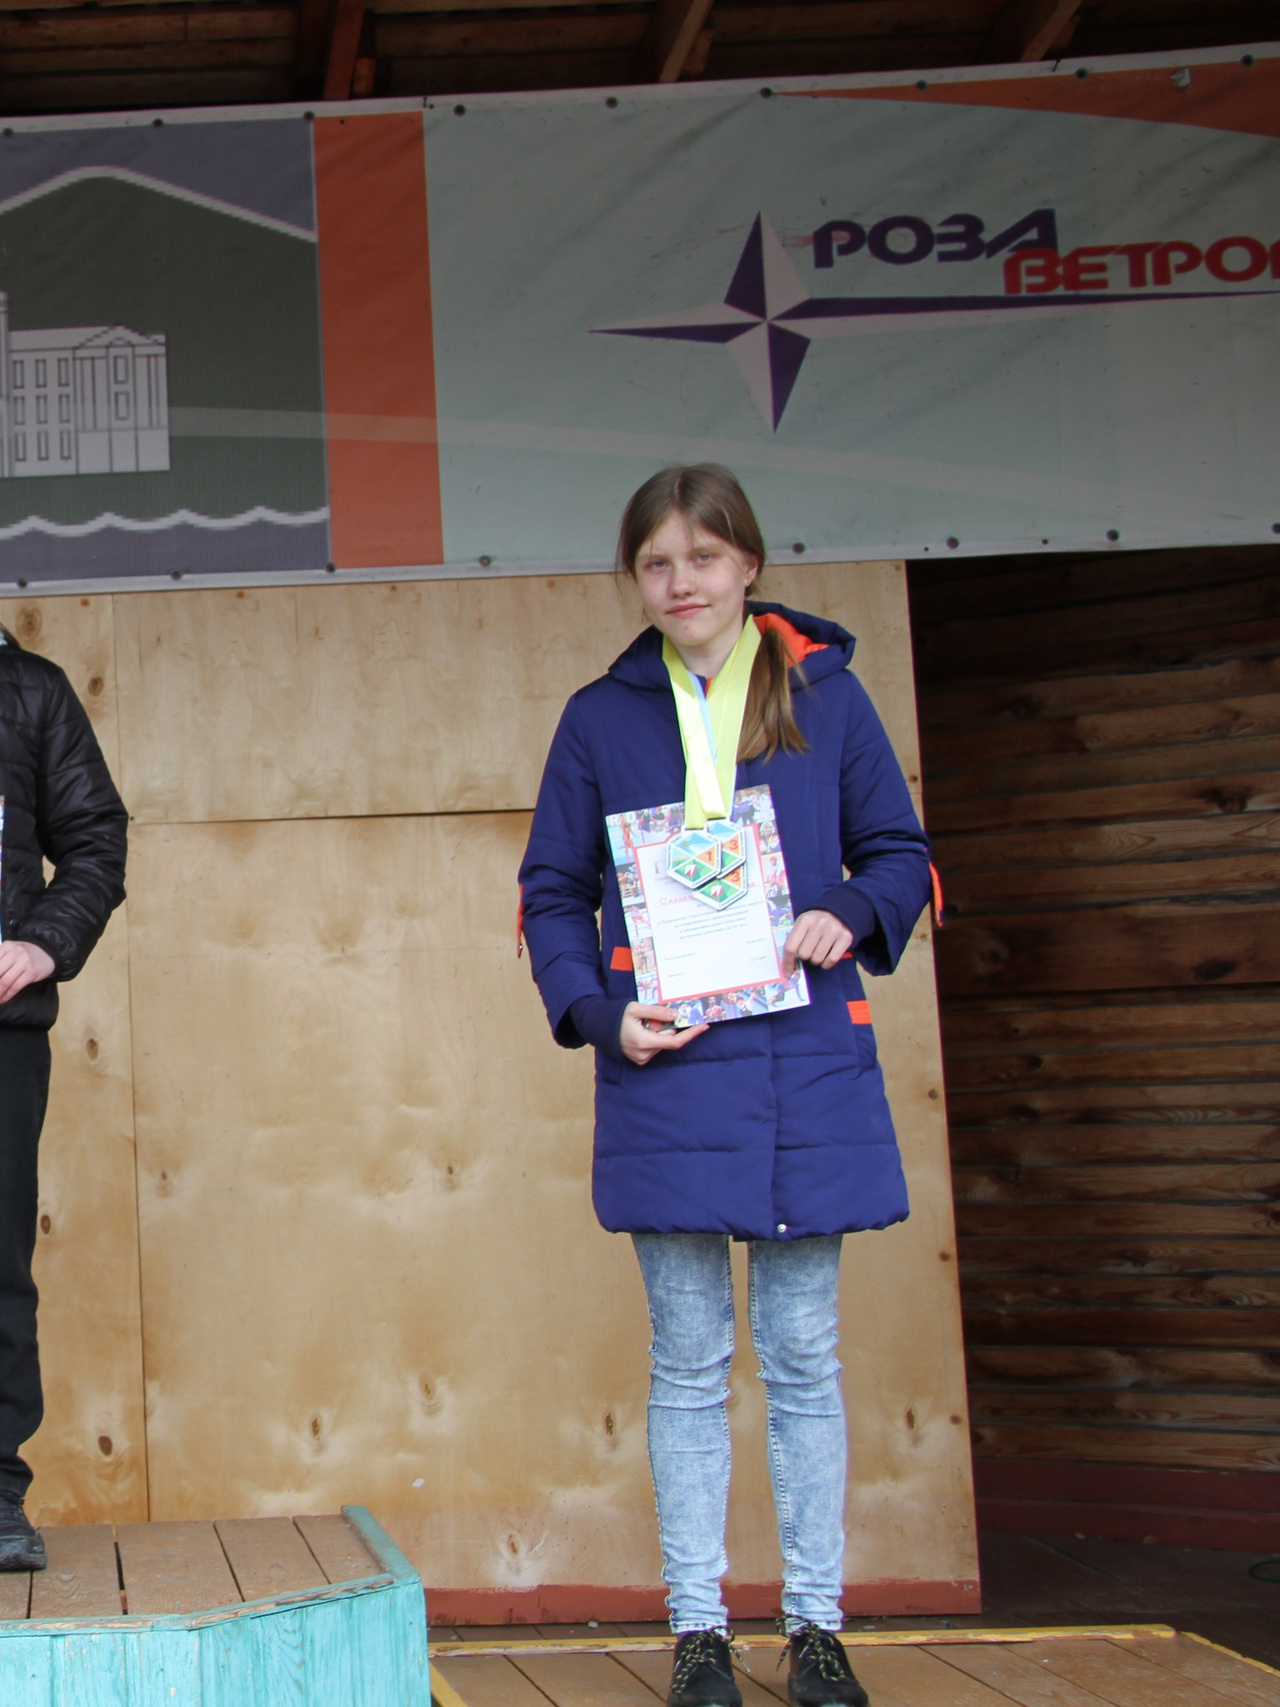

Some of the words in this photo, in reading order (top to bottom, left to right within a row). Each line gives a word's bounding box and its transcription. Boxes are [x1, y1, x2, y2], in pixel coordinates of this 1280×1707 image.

[812, 208, 1058, 269] РОЗА
[1003, 235, 1280, 295] ВЕТРО
[729, 839, 739, 850] 3
